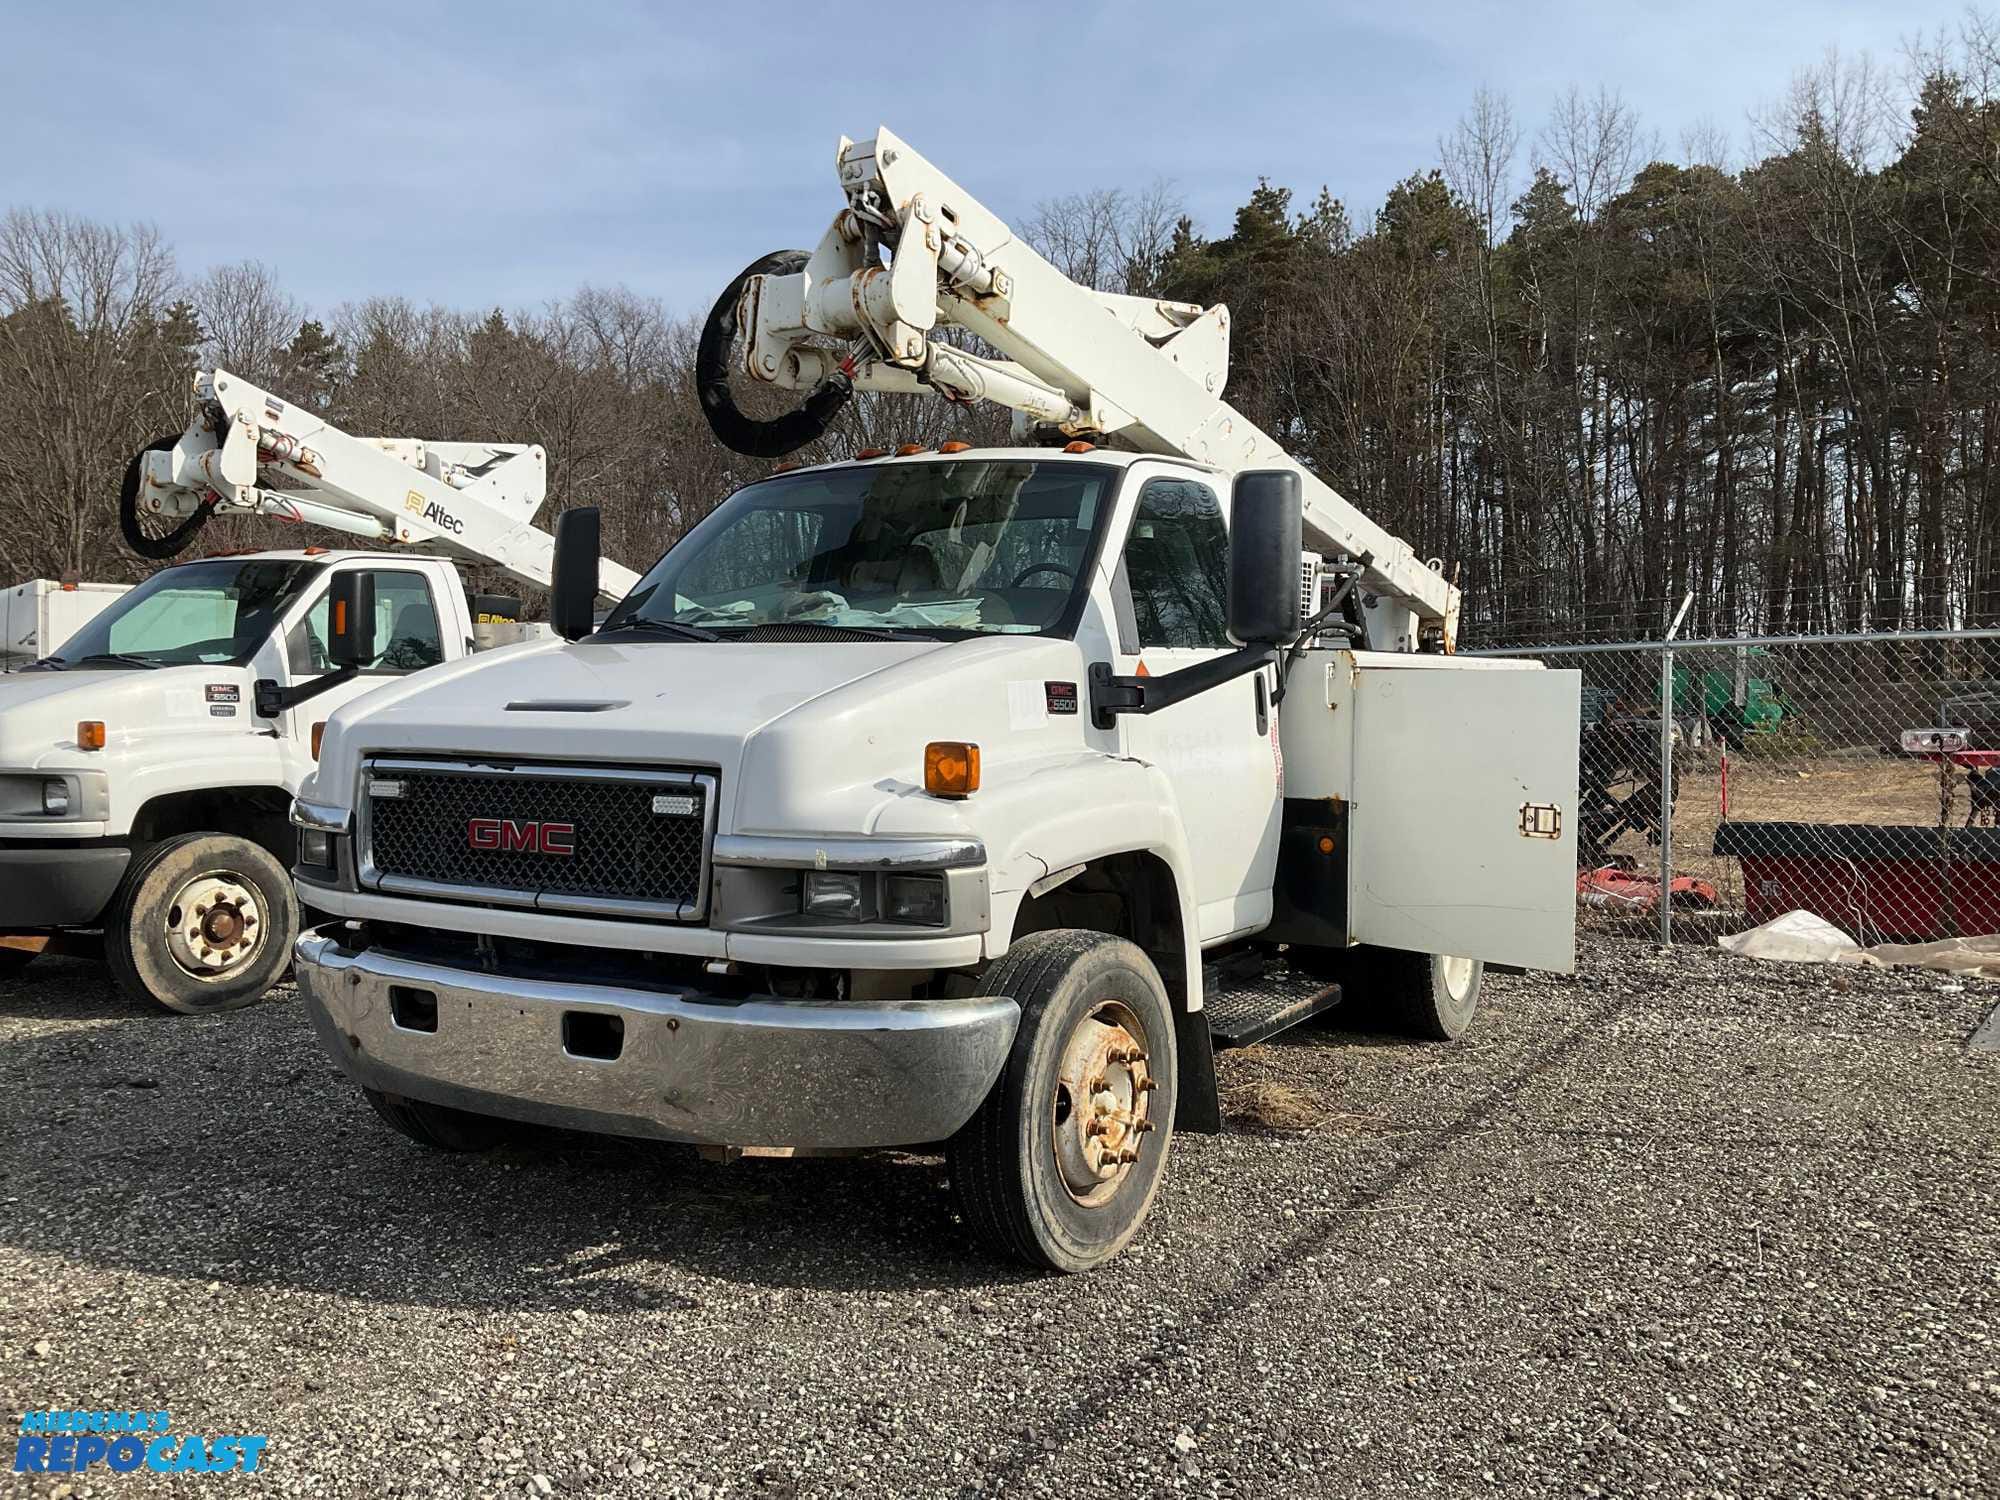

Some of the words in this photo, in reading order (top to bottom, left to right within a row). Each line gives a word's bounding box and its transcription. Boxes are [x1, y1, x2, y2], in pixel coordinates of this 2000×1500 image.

[423, 502, 464, 534] Altec
[1051, 685, 1073, 696] GMC
[468, 818, 575, 855] GMC
